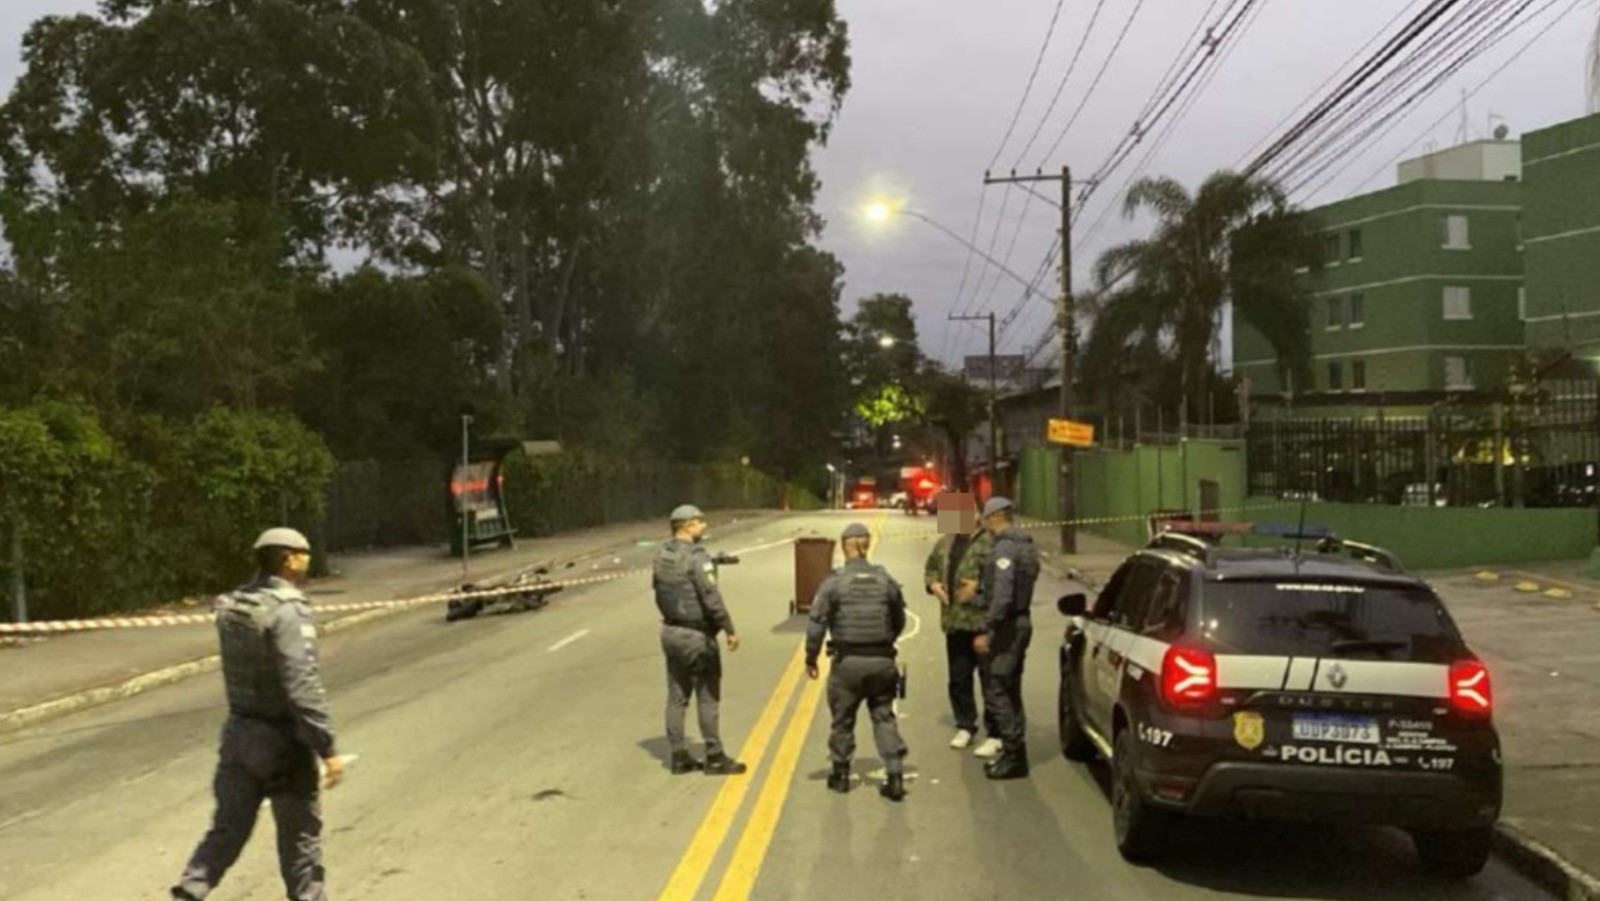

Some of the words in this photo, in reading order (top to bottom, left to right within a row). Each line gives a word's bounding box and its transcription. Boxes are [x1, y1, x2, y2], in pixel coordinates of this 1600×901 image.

[1146, 726, 1173, 747] 197
[1281, 744, 1391, 766] POLÍCIA
[1430, 757, 1454, 769] 197
